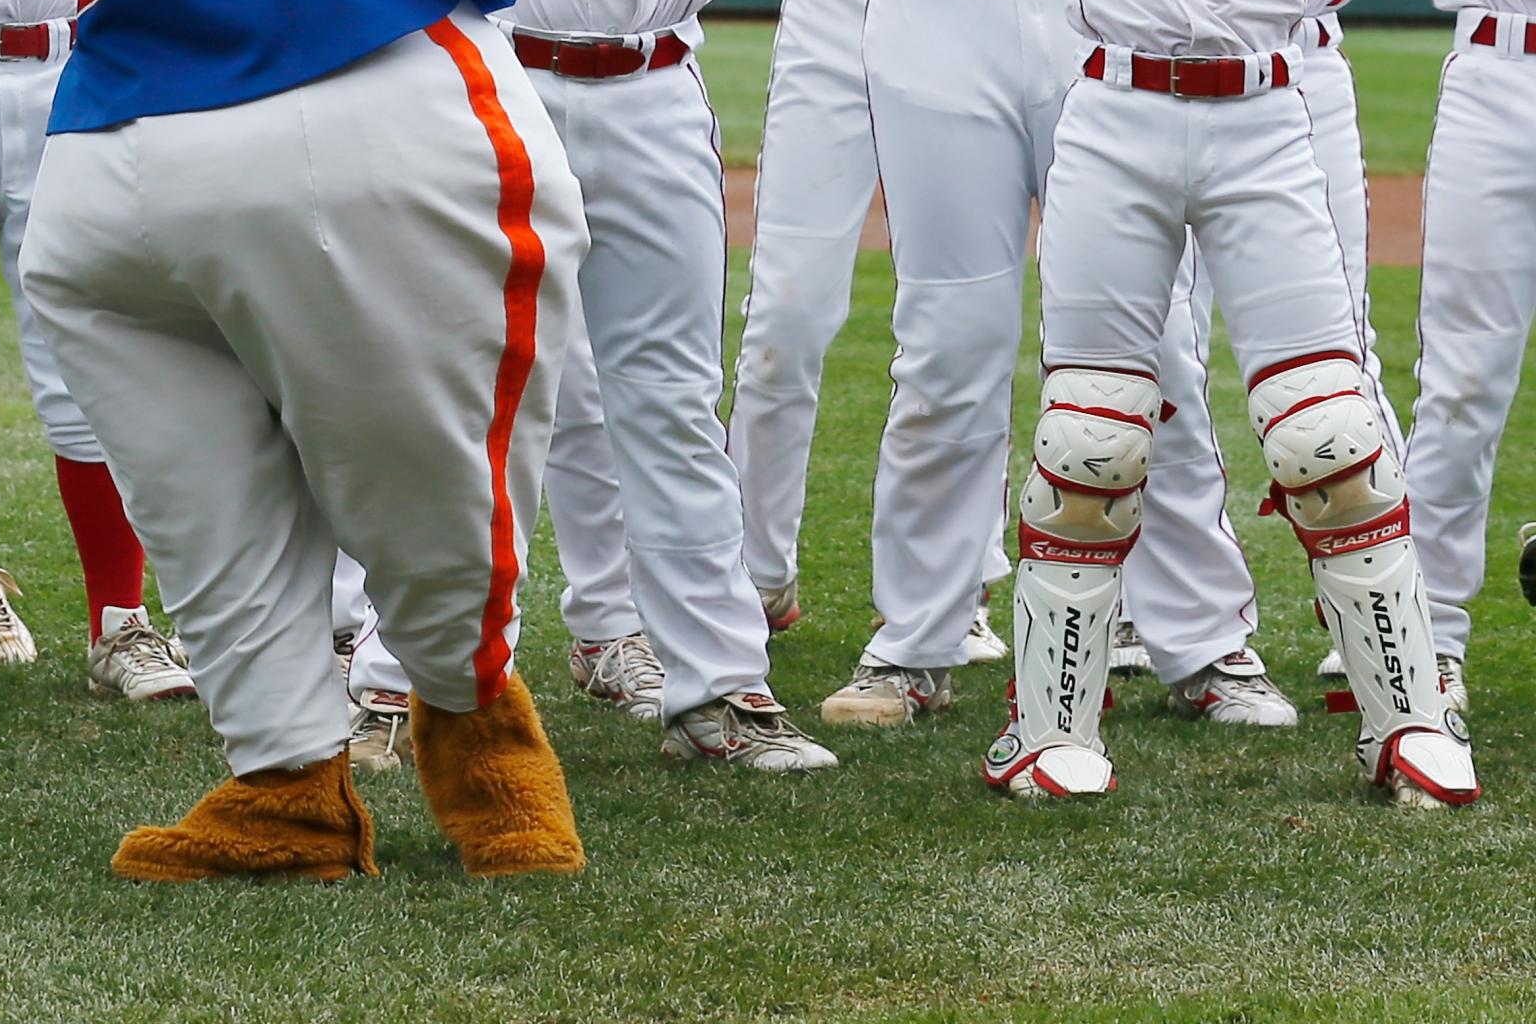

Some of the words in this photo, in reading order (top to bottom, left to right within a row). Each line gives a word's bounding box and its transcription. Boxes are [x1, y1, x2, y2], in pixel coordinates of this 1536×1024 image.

[1045, 545, 1119, 560] EASTON
[1332, 520, 1402, 549] EASTON
[1057, 605, 1082, 734] EASTON
[1368, 590, 1412, 715] EASTON
